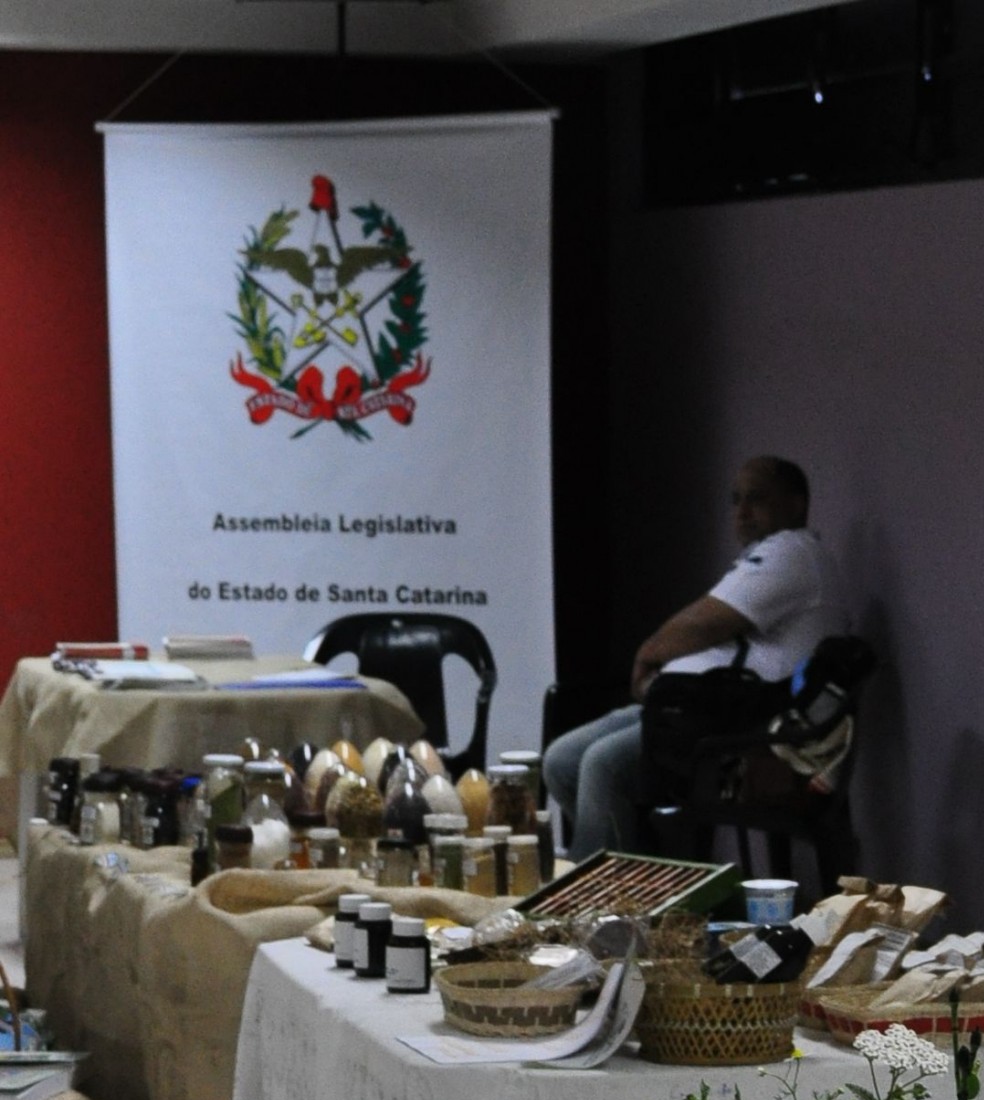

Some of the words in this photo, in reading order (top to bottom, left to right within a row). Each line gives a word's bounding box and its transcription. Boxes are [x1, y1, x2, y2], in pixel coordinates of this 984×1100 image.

[212, 512, 331, 534] Assembleia
[339, 514, 457, 538] Legislativa
[188, 581, 211, 601] do
[218, 582, 288, 602] Estado
[295, 583, 321, 604] de
[328, 583, 389, 604] Santa
[395, 585, 488, 607] Catarina
